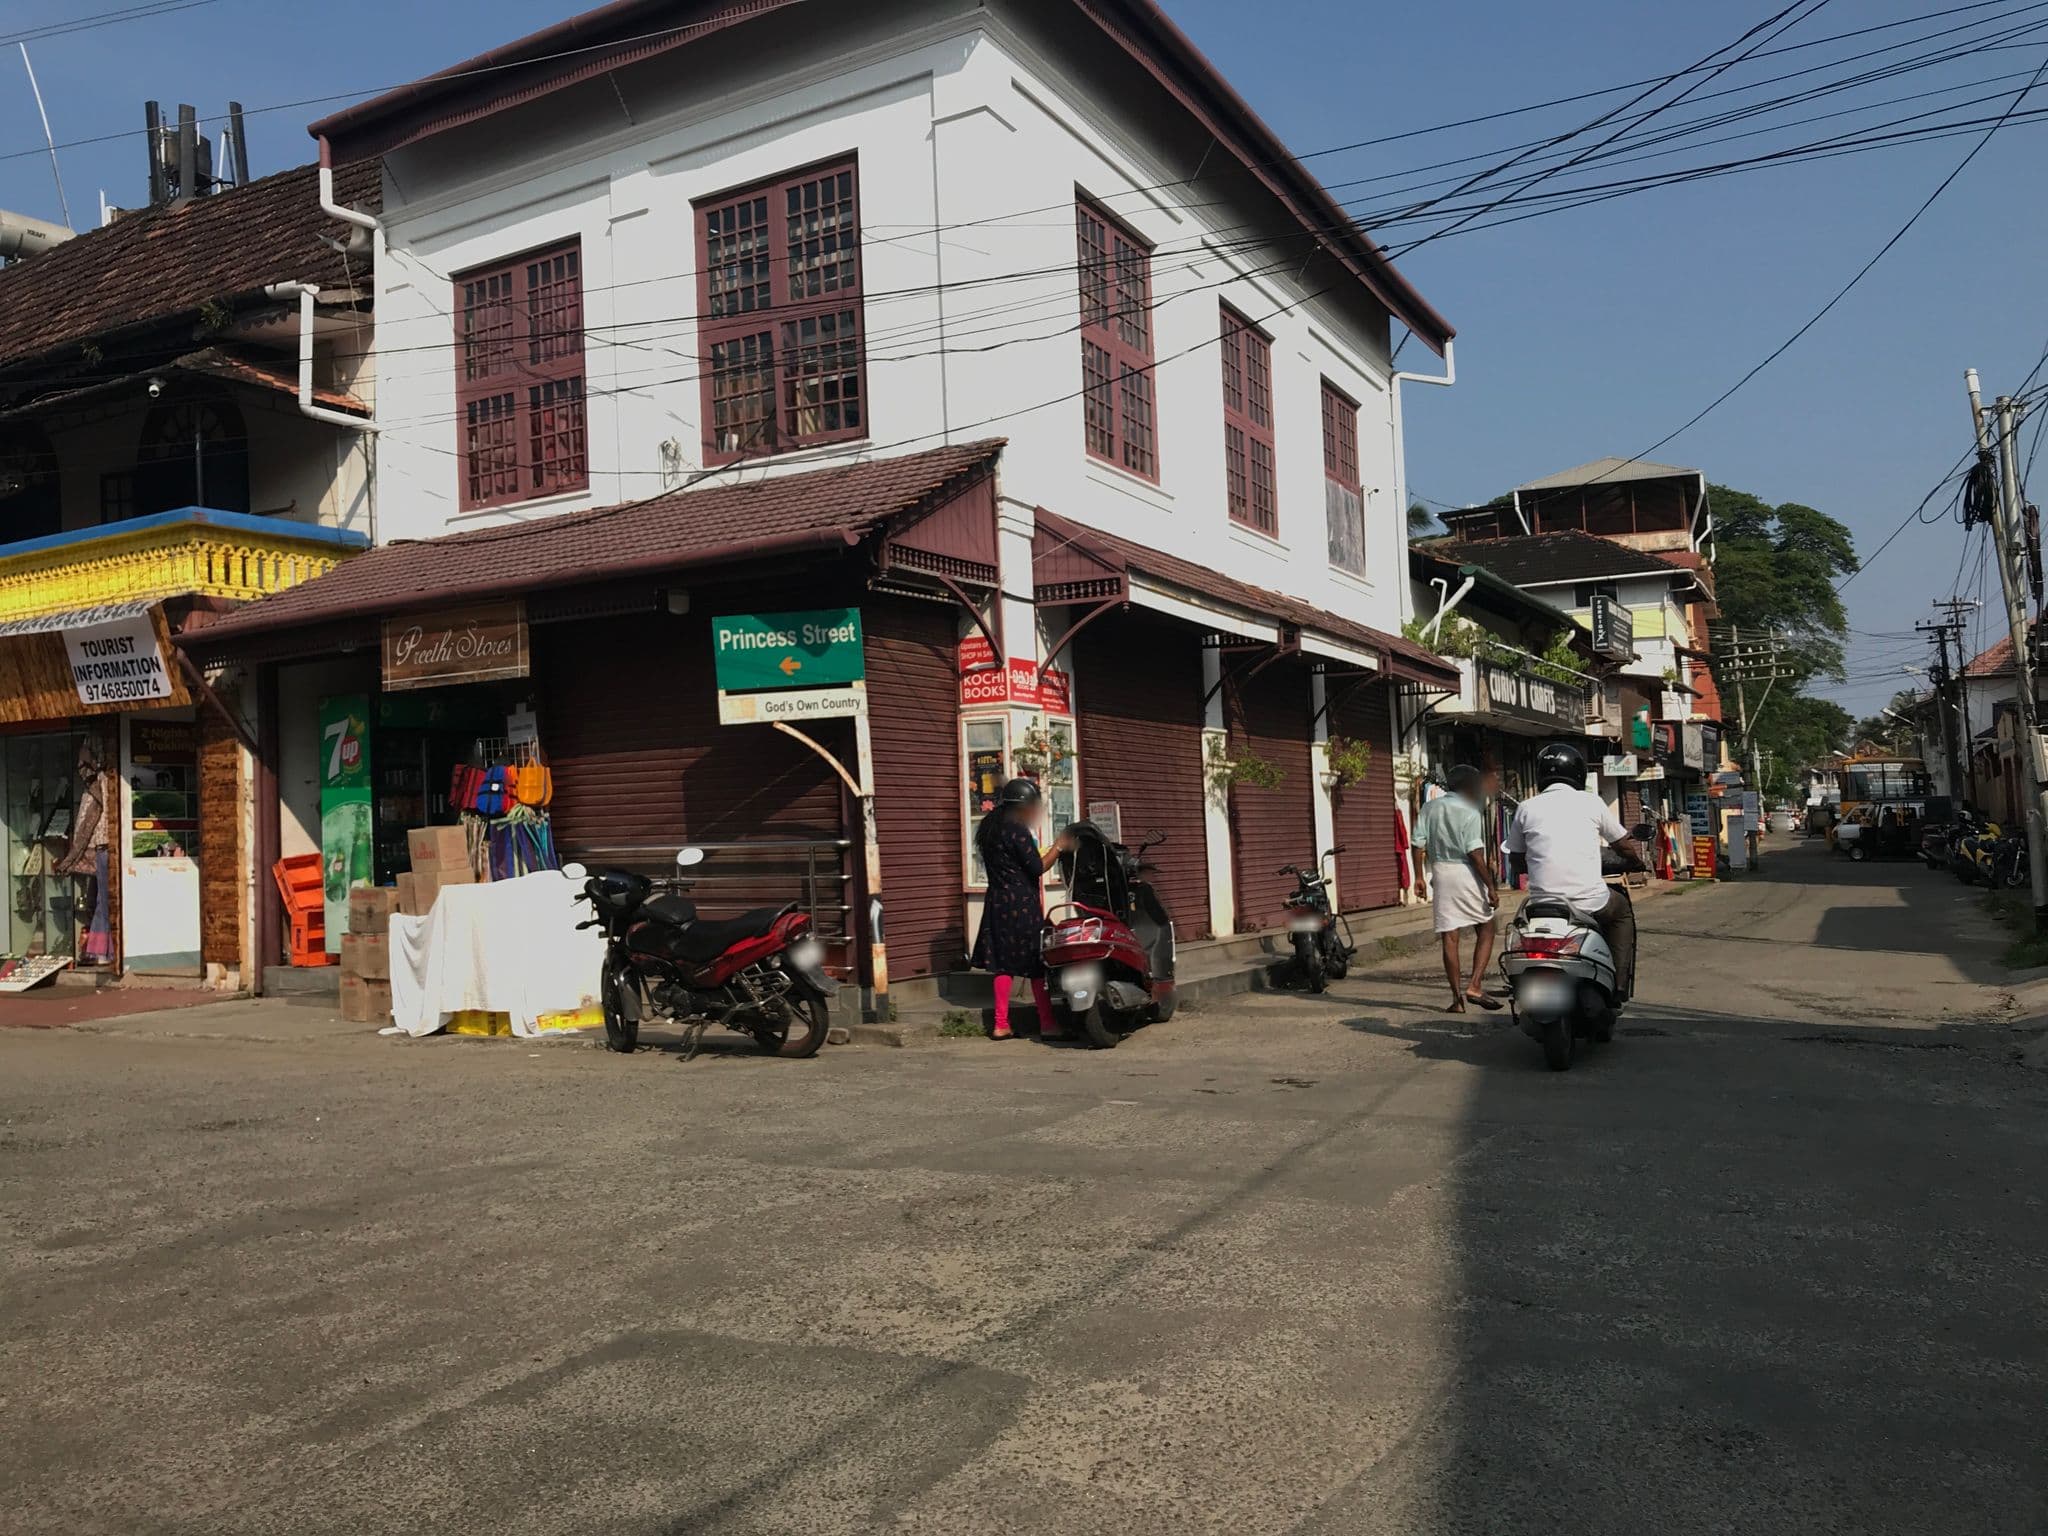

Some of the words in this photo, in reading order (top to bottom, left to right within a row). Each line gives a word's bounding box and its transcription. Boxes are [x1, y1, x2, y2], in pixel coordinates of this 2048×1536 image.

[80, 636, 135, 658] TOURIST
[396, 626, 455, 666] Preethi
[456, 619, 512, 659] Stores
[719, 628, 797, 651] Princess
[802, 622, 857, 645] Street
[73, 656, 161, 682] INFORMATION
[963, 672, 1005, 686] KOCHI
[86, 678, 160, 701] 9746850074
[964, 685, 1006, 699] BOOKS
[1489, 667, 1517, 706] CURIO
[1519, 676, 1527, 708] N
[1529, 680, 1556, 715] CRAFTS
[765, 700, 794, 713] God's
[796, 700, 819, 712] Own
[821, 697, 861, 711] Country
